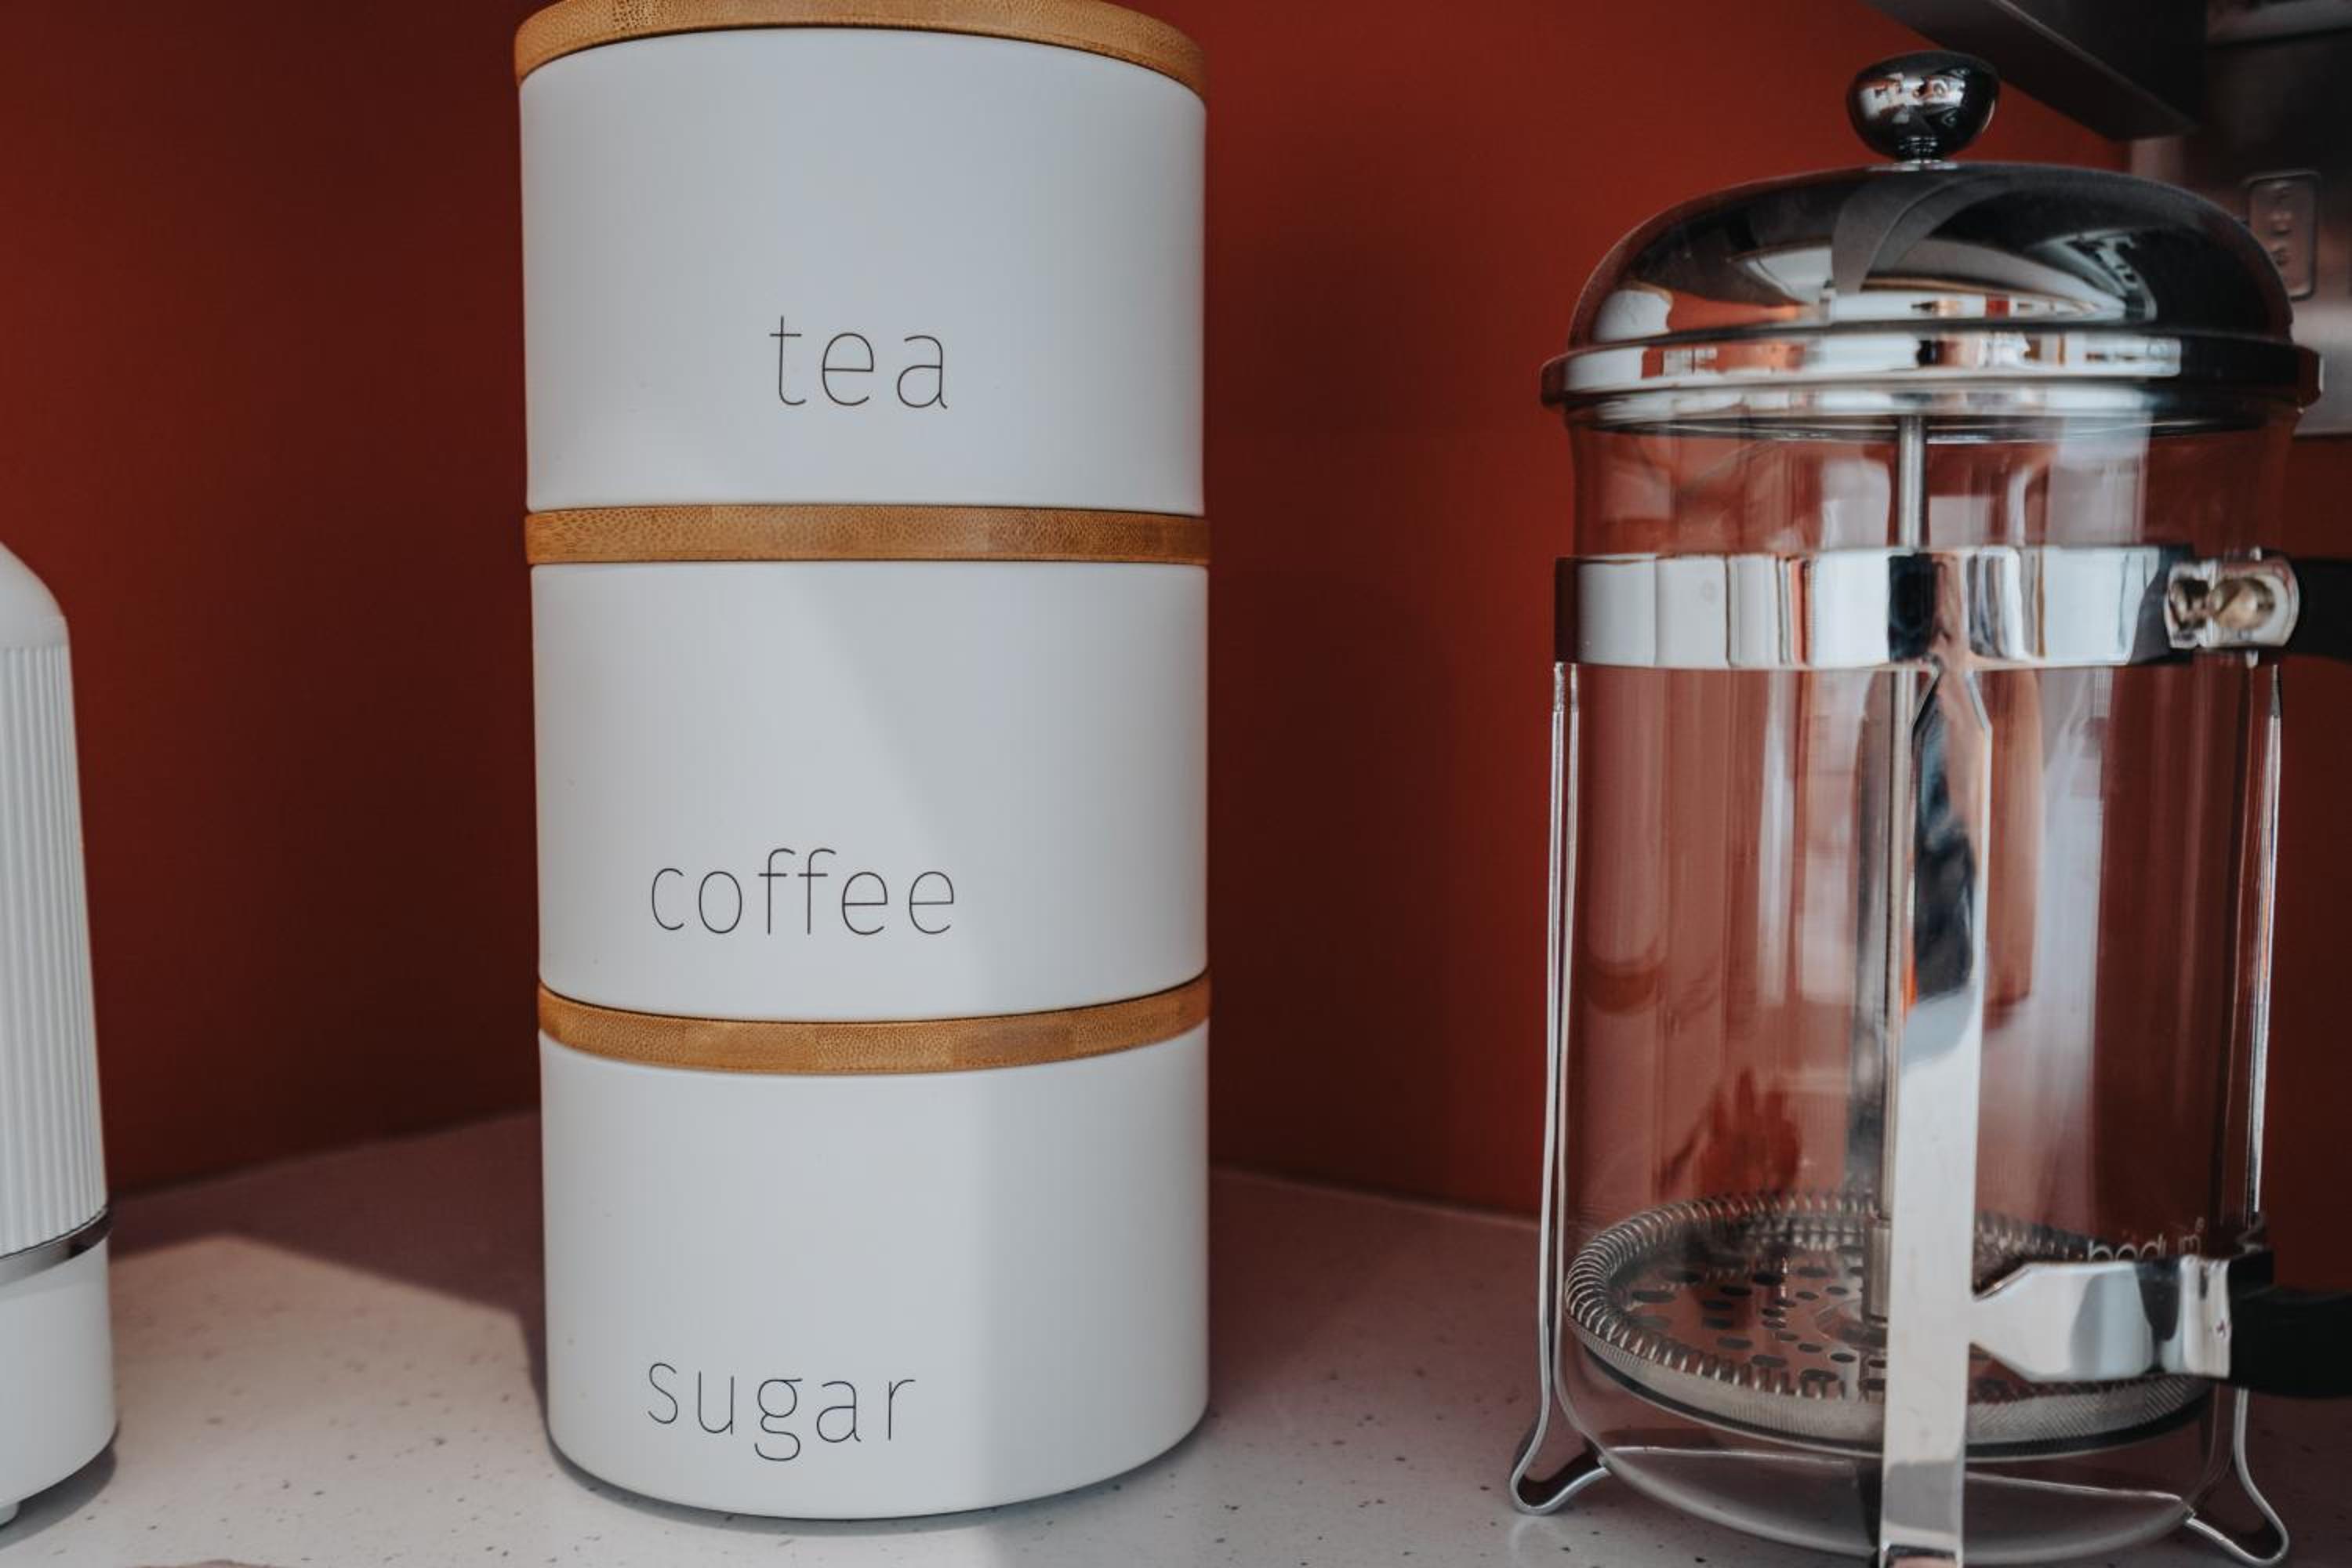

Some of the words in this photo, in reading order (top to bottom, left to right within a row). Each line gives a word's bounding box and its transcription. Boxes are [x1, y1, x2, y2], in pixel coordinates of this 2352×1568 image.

[768, 314, 949, 410] tea
[651, 847, 955, 937] coffee
[647, 1361, 916, 1463] sugar
